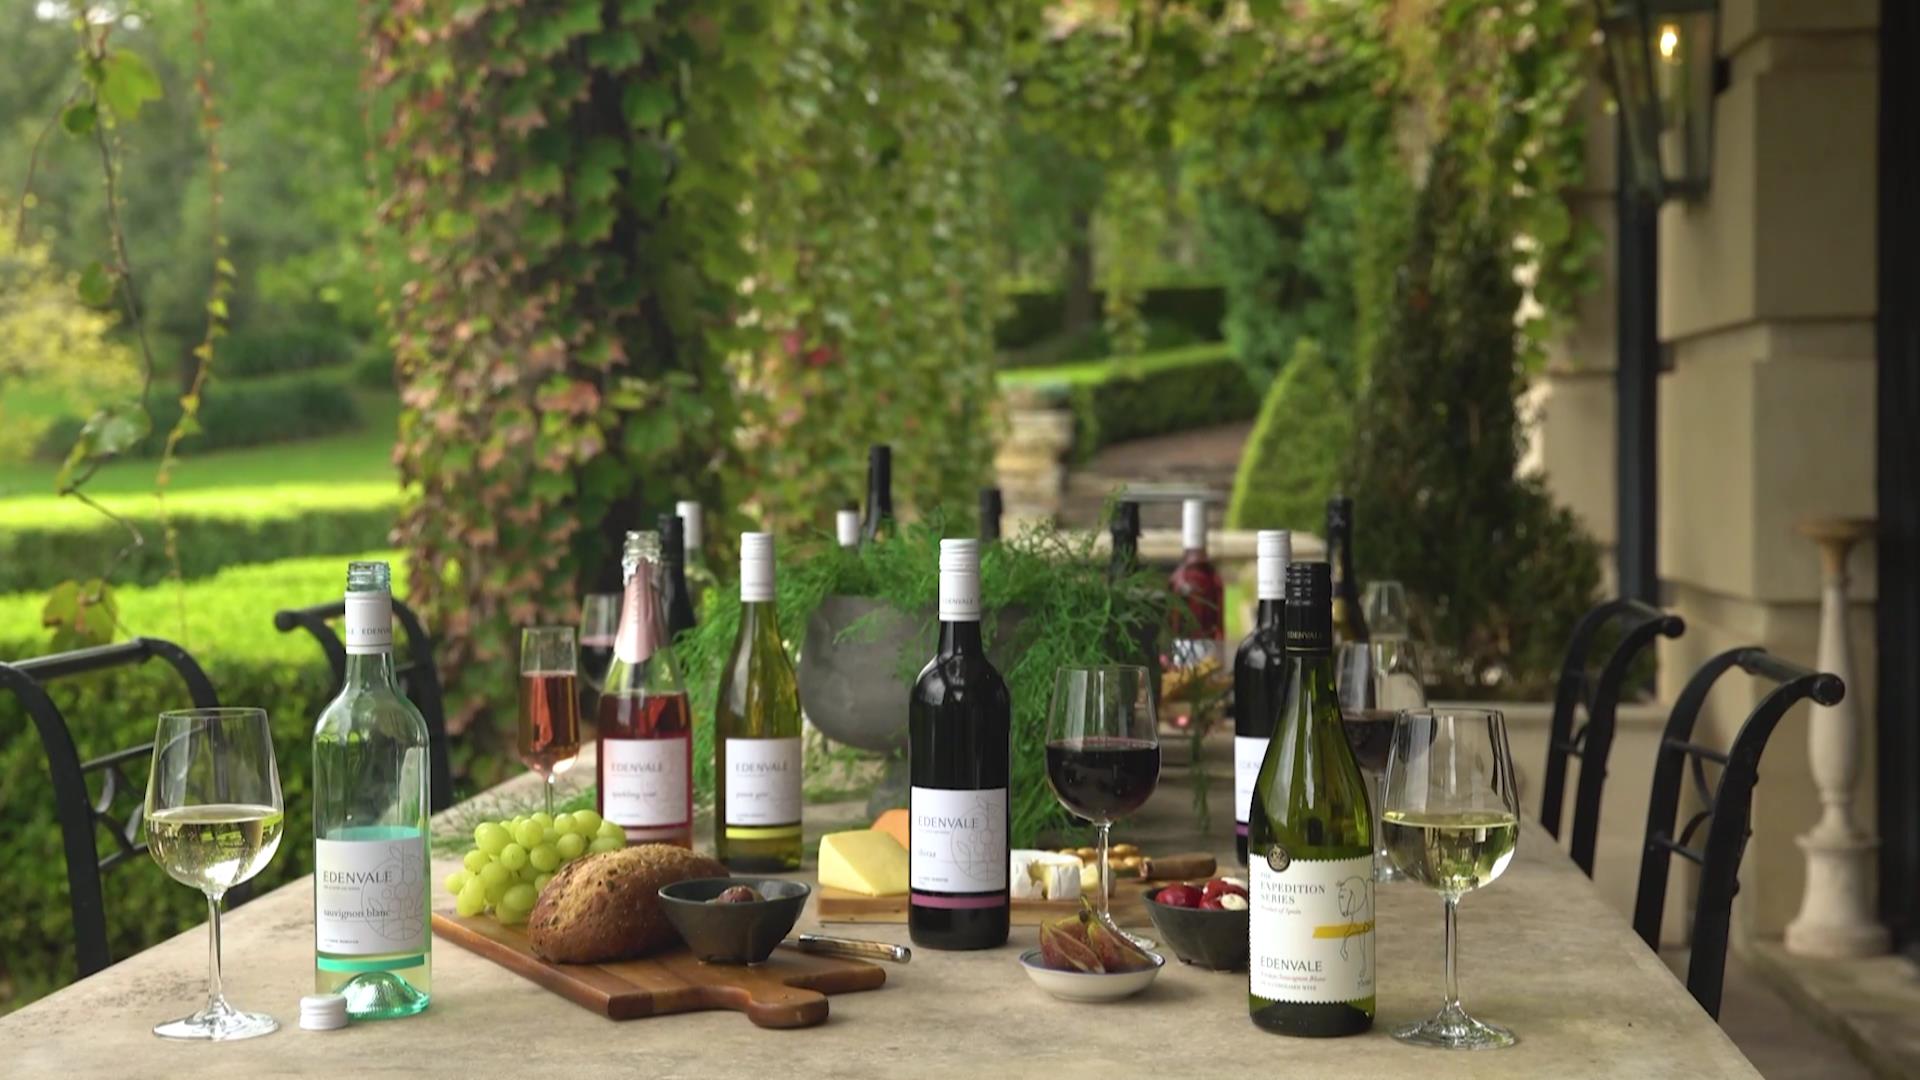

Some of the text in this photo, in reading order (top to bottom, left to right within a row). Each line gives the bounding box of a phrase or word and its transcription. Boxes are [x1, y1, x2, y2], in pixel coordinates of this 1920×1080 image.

[612, 761, 663, 773] EDENVALE
[735, 761, 787, 772] EDENVALE
[918, 815, 979, 829] EDENVALE
[323, 870, 393, 884] EDENVALE
[1260, 881, 1326, 895] EXPEDITION
[1260, 893, 1296, 905] SERIES
[323, 906, 390, 920] sauvignon blanc
[1260, 955, 1324, 973] EDENVALE
